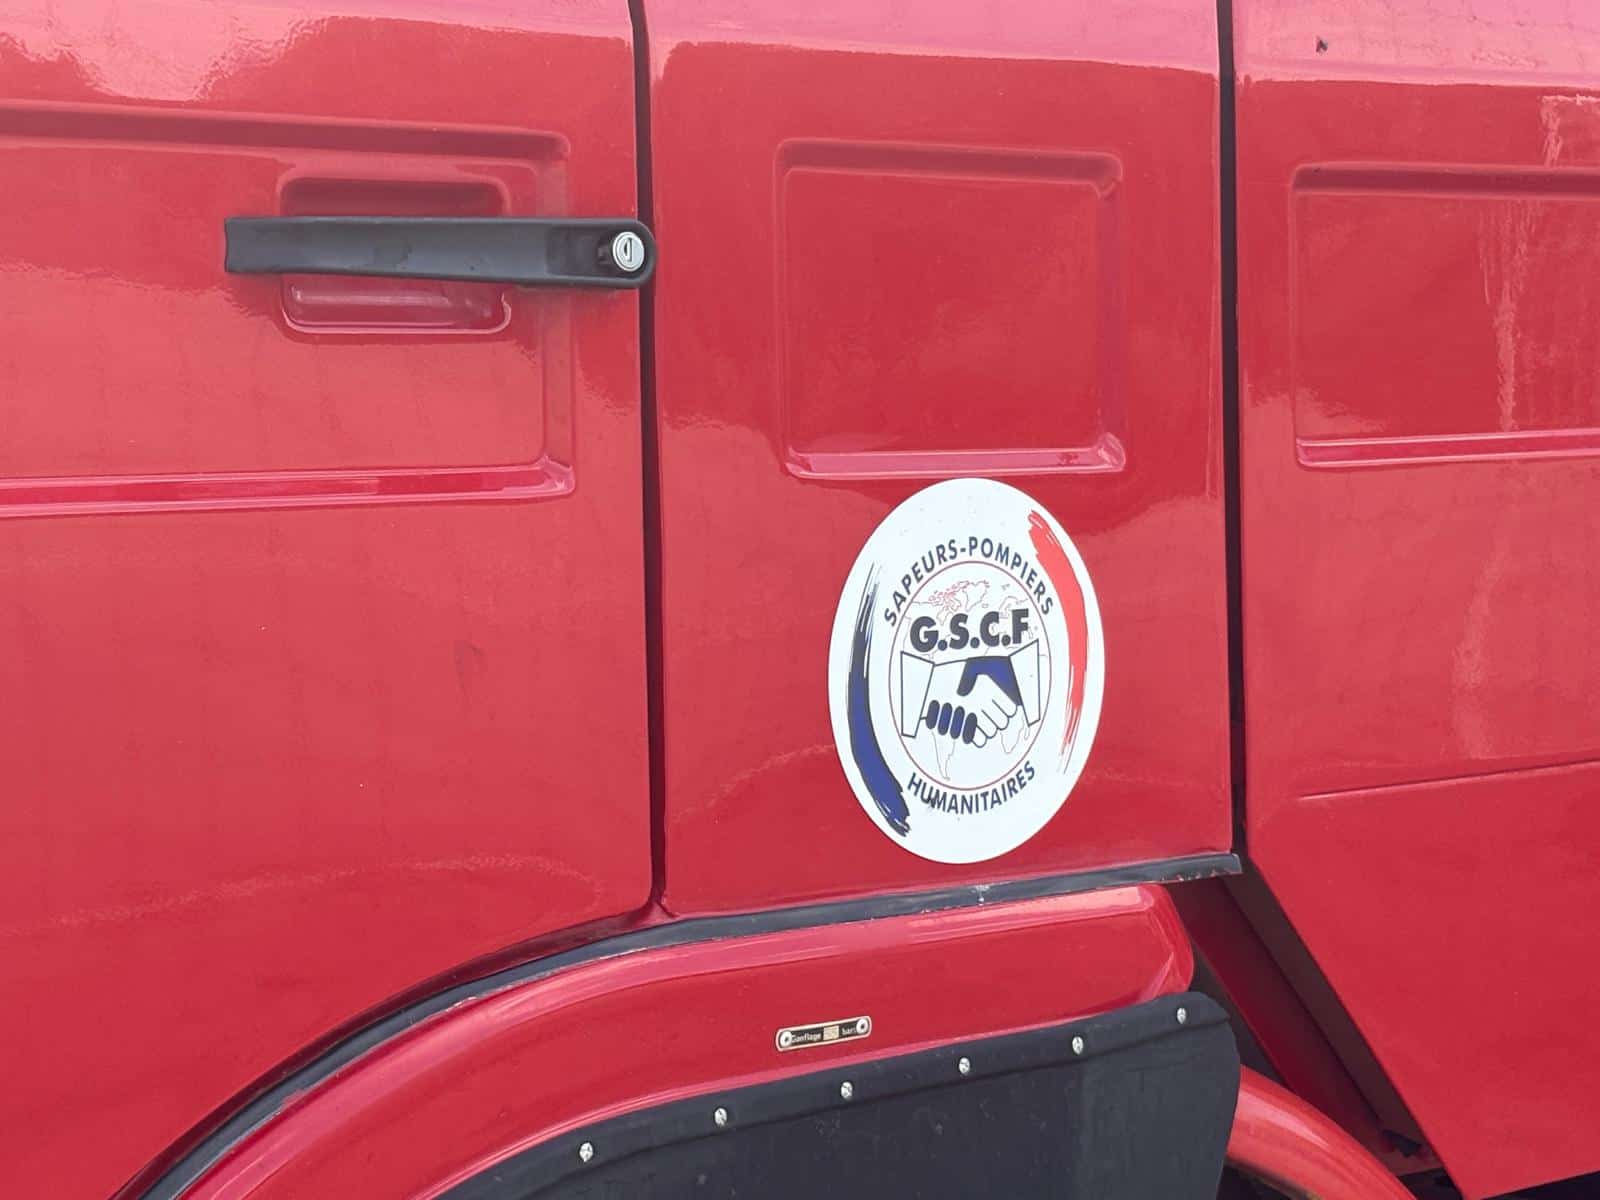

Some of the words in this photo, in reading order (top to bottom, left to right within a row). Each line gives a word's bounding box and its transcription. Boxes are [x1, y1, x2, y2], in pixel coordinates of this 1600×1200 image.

[884, 536, 1053, 626] SAPEURS-POMPIERS
[909, 608, 1030, 652] G.S.C.F
[907, 761, 1035, 814] HUMANITAIRES
